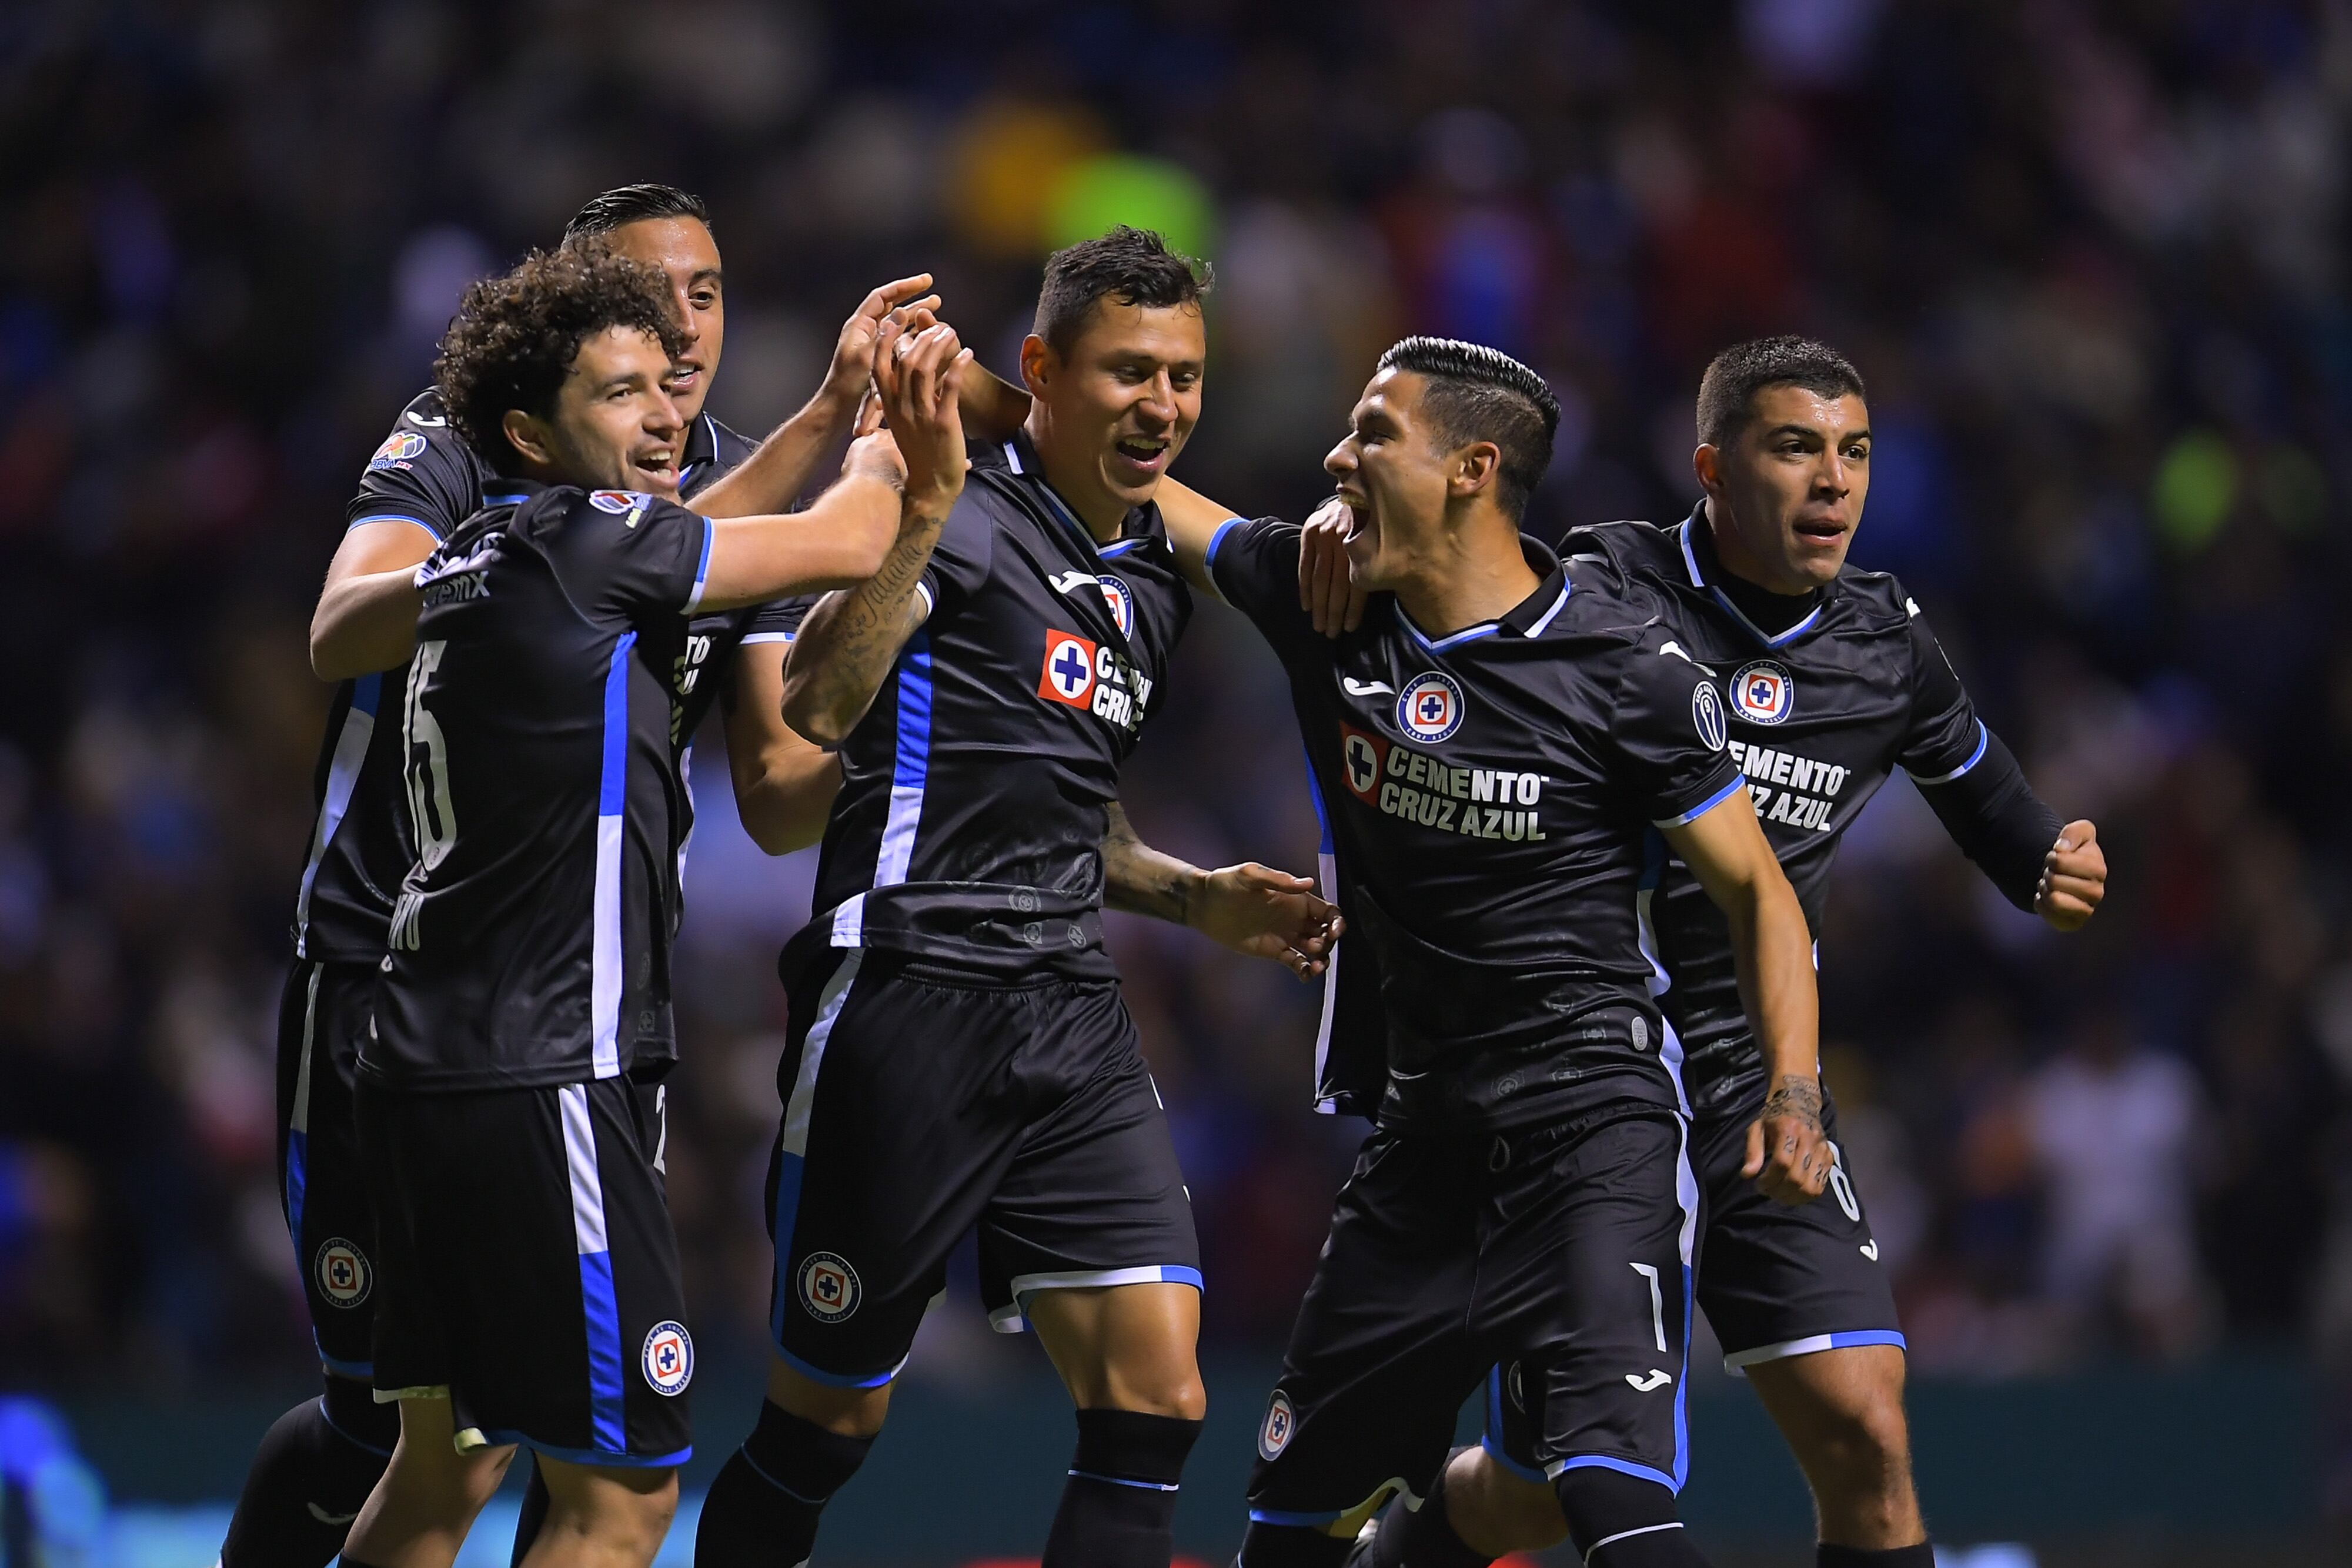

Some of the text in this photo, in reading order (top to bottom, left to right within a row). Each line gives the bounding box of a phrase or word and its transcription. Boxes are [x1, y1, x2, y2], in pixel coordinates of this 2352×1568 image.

[1387, 745, 1541, 805] CEMENTO
[1728, 740, 1845, 796] EMENTO
[1380, 782, 1546, 841] CRUZ AZUL
[1767, 792, 1833, 831] AZUL
